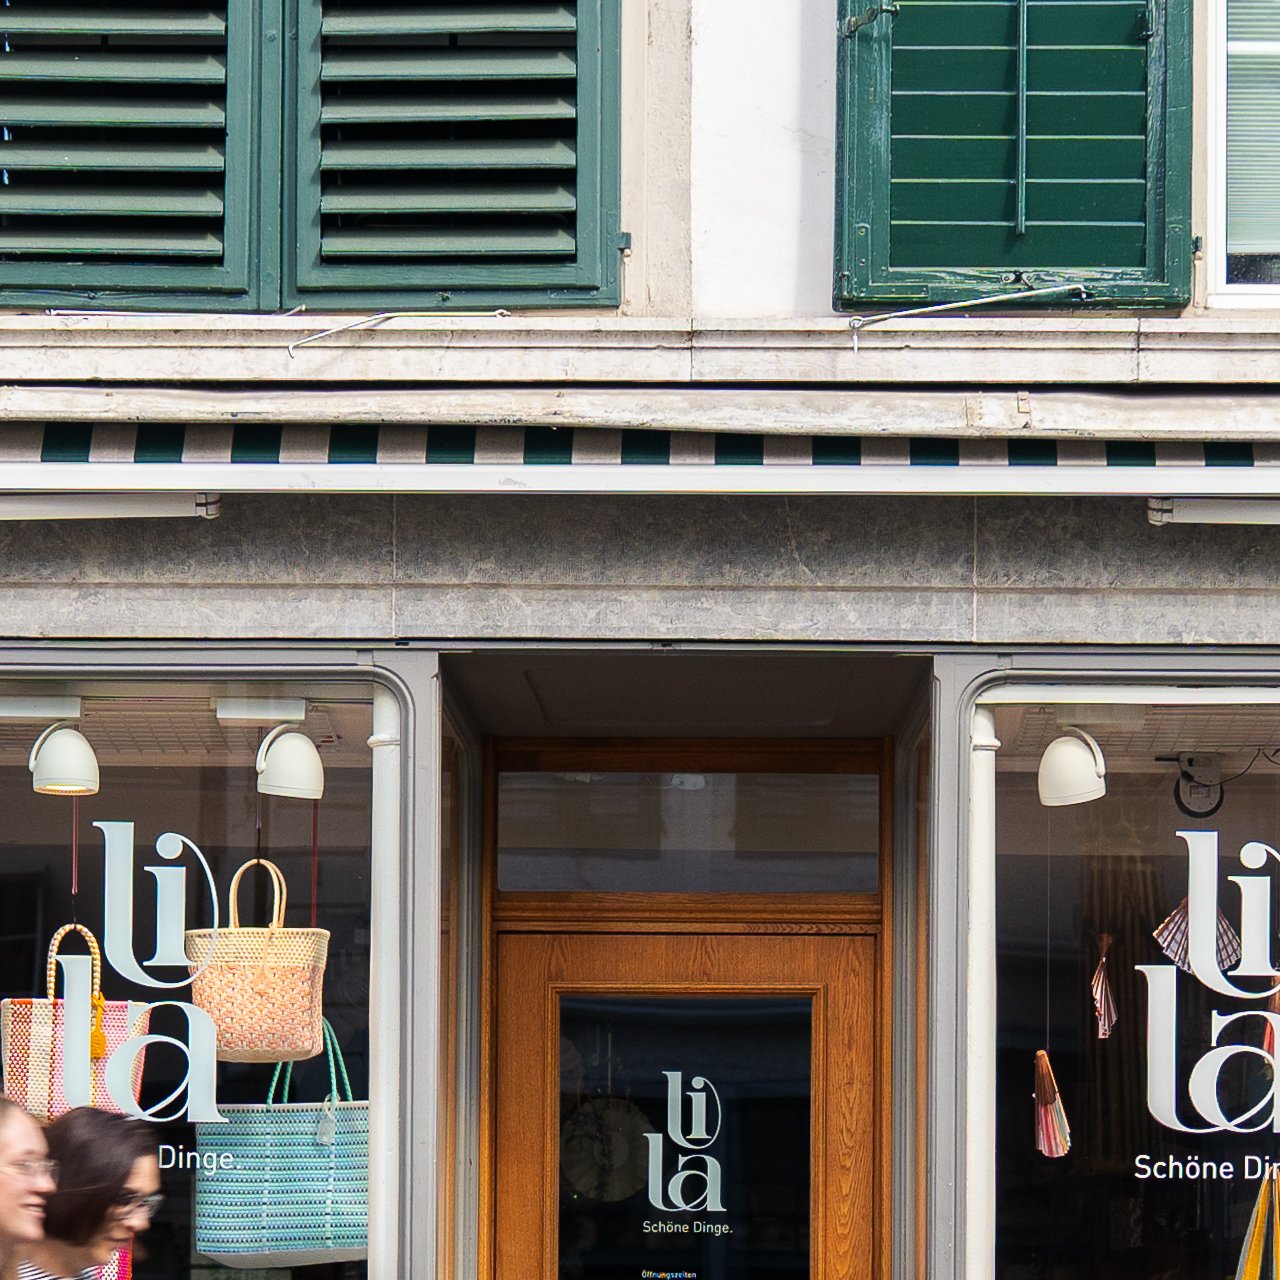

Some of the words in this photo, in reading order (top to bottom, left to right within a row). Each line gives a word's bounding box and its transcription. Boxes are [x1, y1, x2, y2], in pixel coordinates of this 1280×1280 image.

[92, 820, 219, 989] li
[661, 1071, 722, 1149] li
[158, 1144, 241, 1176] Dinge.
[642, 1133, 727, 1212] la
[1134, 1154, 1234, 1180] Schöne
[642, 1220, 690, 1233] Schöne
[693, 1221, 734, 1237] Dinge.
[641, 1269, 697, 1280] Öffnungszeiten
